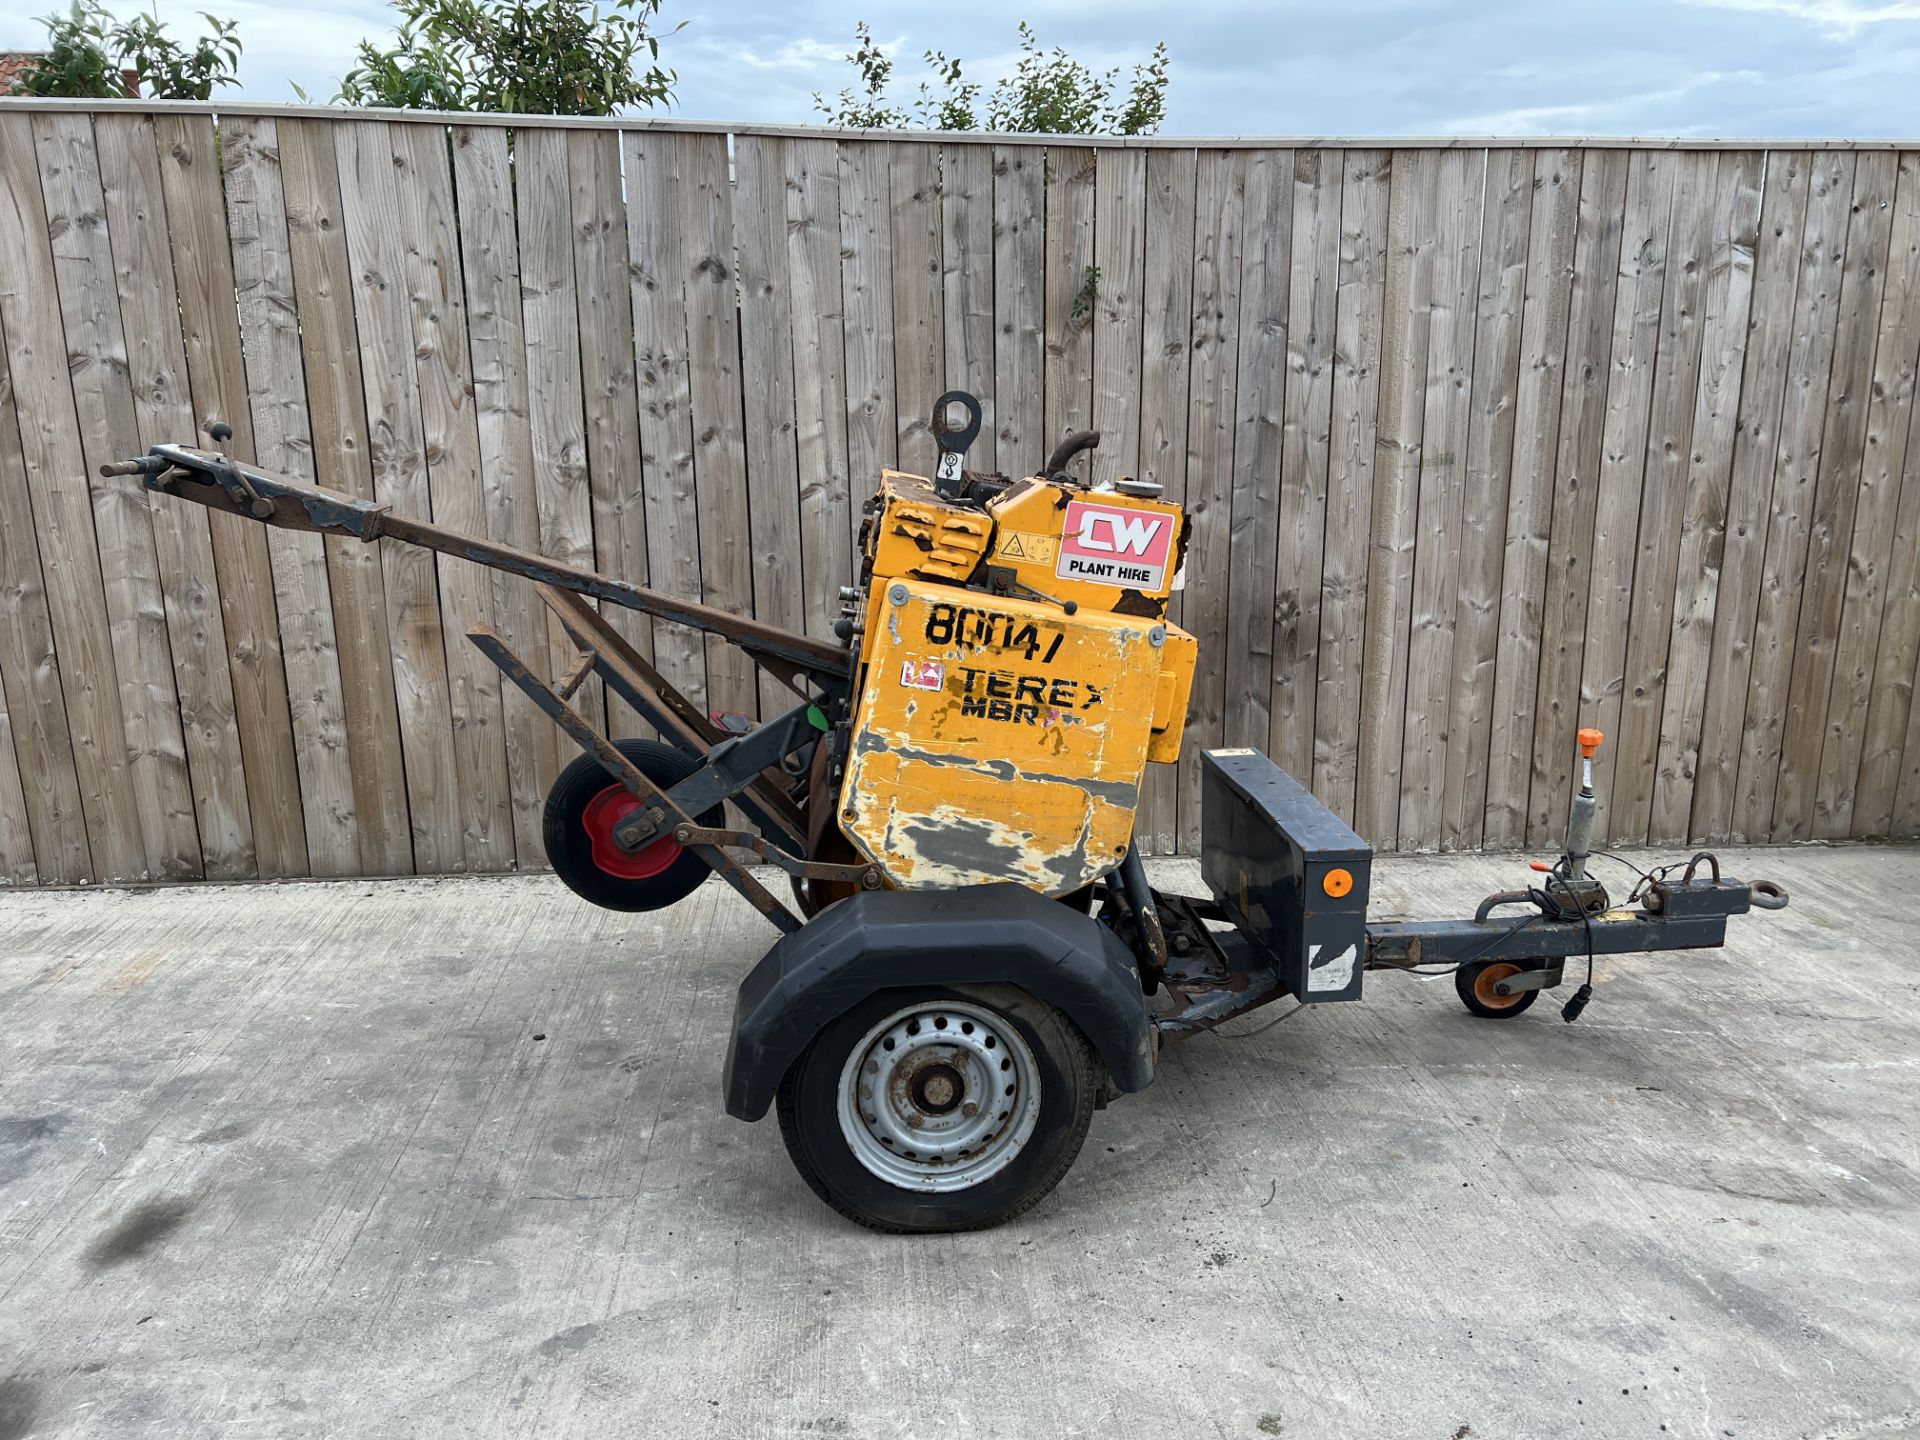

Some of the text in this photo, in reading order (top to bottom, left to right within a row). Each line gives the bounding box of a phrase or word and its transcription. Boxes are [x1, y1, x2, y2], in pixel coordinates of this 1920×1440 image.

[1077, 511, 1162, 557] CW
[1069, 560, 1151, 582] PLANT HIRE
